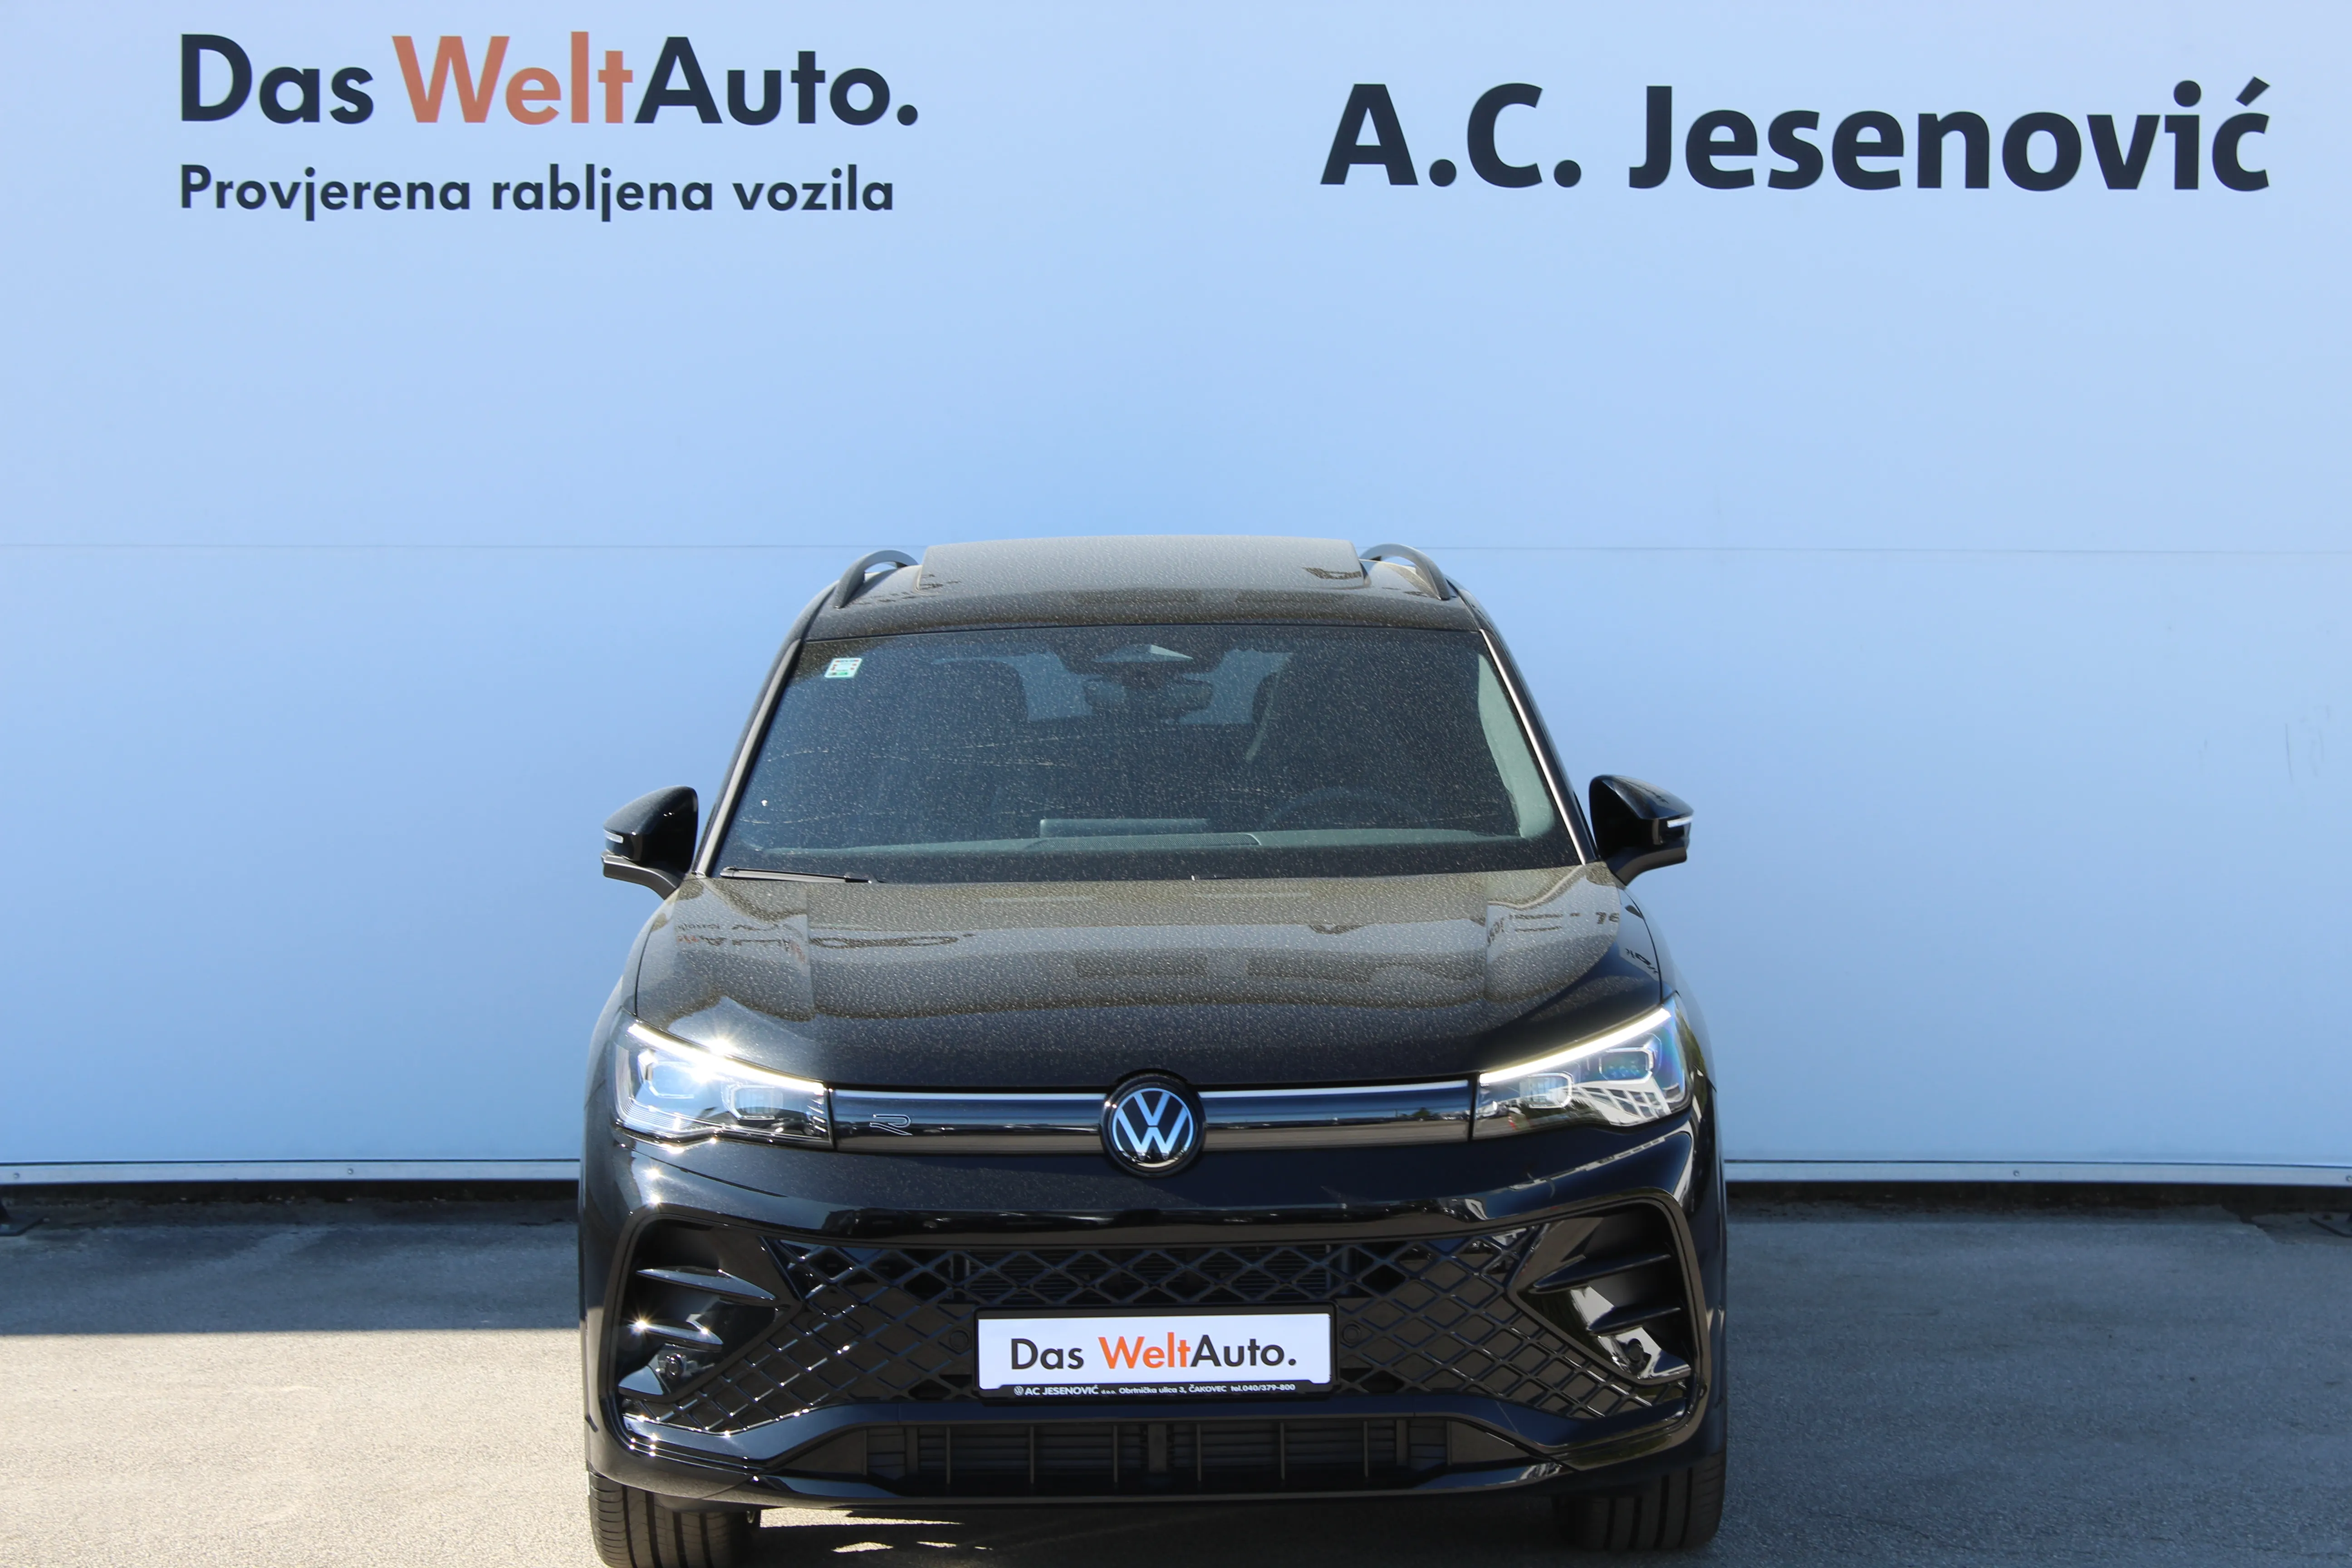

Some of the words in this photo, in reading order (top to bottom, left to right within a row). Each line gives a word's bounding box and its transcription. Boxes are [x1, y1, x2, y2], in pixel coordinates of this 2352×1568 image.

[181, 34, 373, 124] Das
[392, 32, 917, 125] WeltAuto.
[1321, 83, 1581, 188] A.C.
[1629, 77, 2270, 191] Jesenović
[181, 165, 469, 221] Provjerena
[493, 164, 712, 221] rabljena
[733, 164, 892, 211] vozila
[1011, 1338, 1084, 1370] Das
[1098, 1332, 1296, 1369] WeltAuto.
[1024, 1387, 1040, 1395] AC
[1042, 1384, 1099, 1396] JESENOVIĆ
[1189, 1384, 1227, 1392] ČAKOVEC
